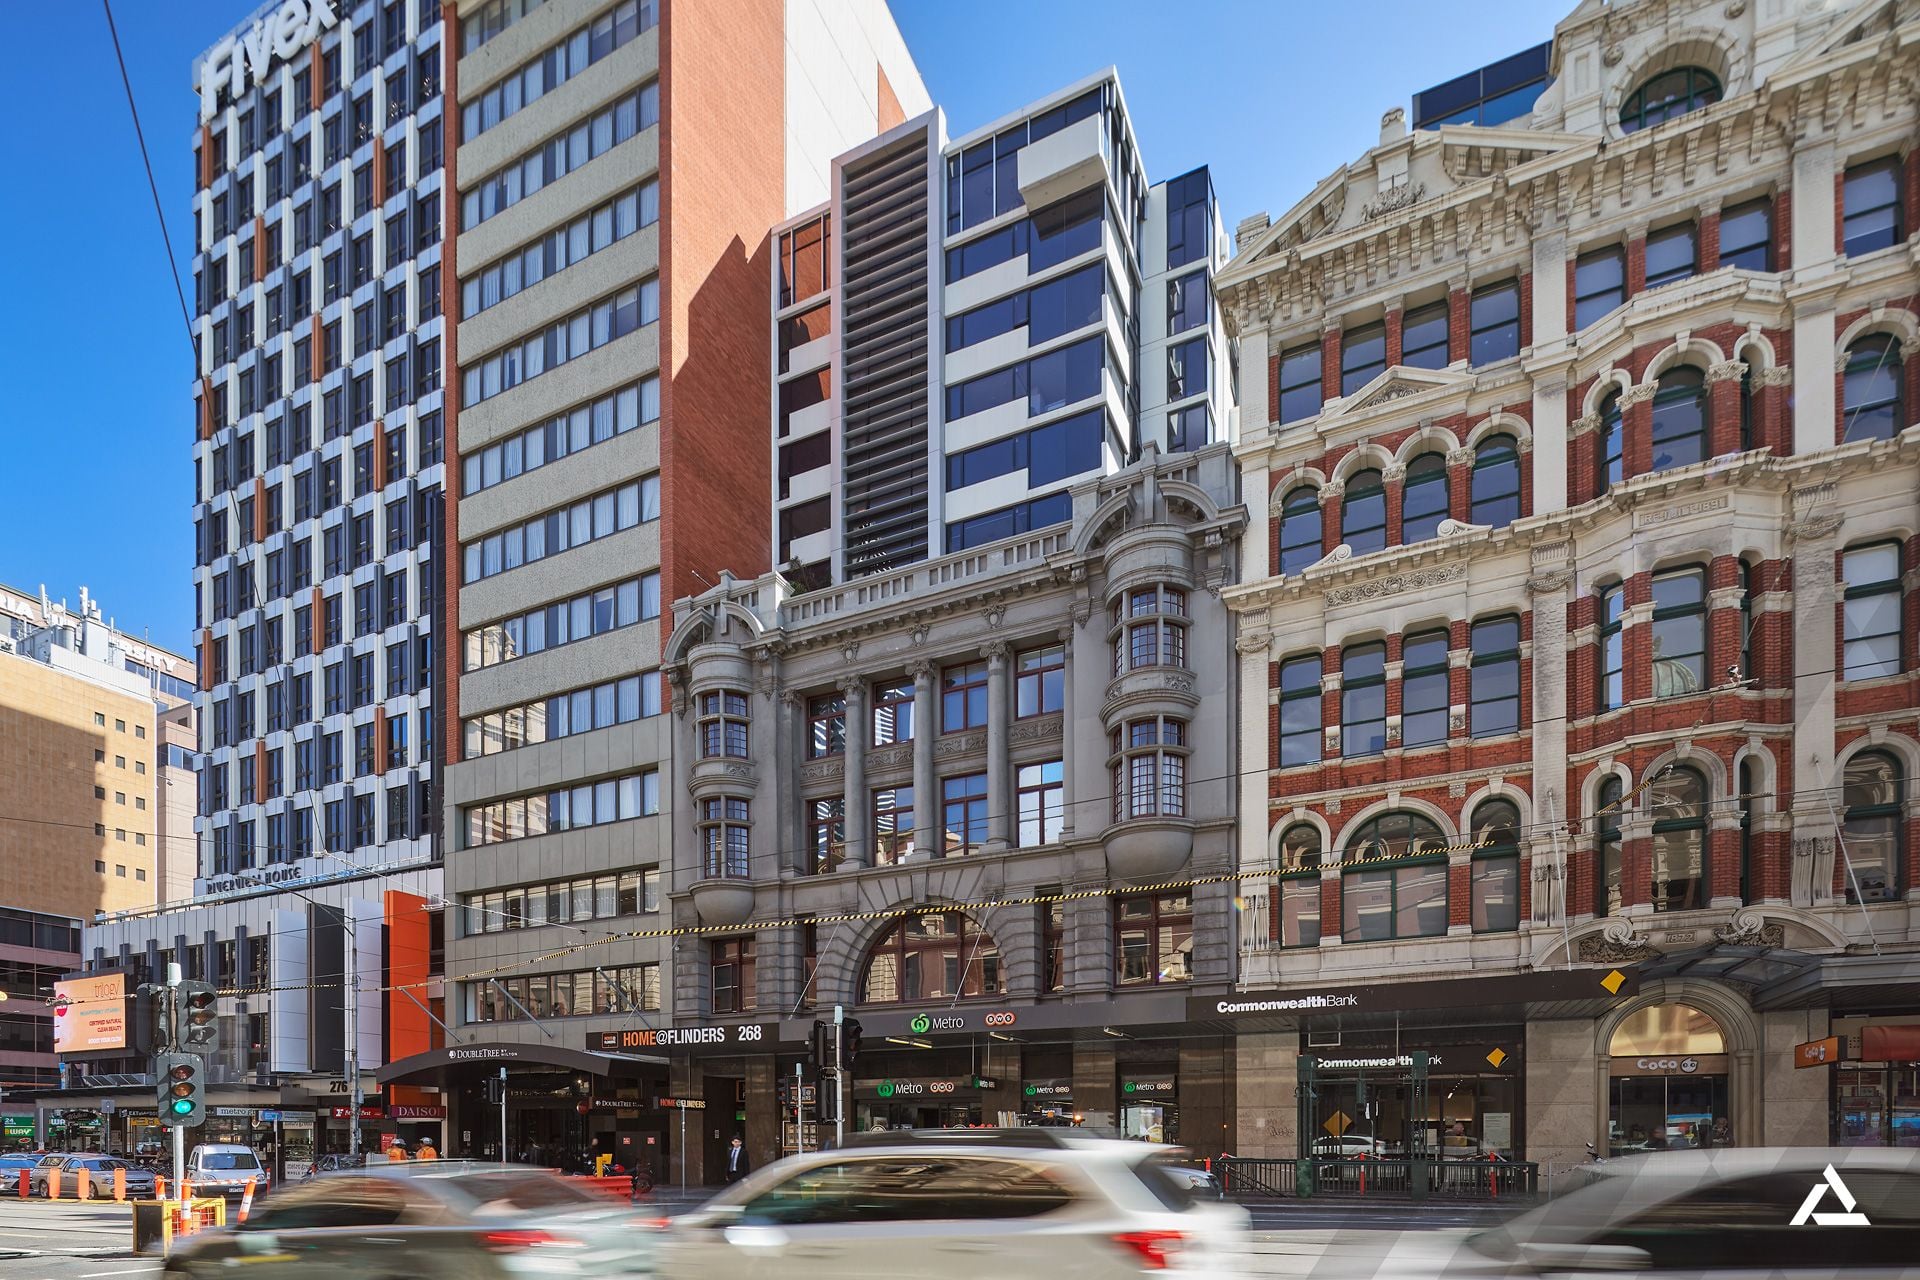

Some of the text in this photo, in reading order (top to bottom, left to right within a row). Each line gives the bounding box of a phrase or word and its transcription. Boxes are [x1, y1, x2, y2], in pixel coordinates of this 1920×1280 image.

[265, 867, 302, 884] HOUSE
[1667, 932, 1694, 943] 1872
[1217, 994, 1358, 1013] CommonwealthBank
[933, 1013, 1013, 1029] Metro BWS
[623, 1027, 725, 1047] HOME@FLINDERS
[738, 1025, 762, 1042] 268
[330, 1081, 347, 1093] 276
[895, 1083, 923, 1094] Metro
[1136, 1083, 1155, 1091] Metro
[399, 1106, 437, 1116] DAISO
